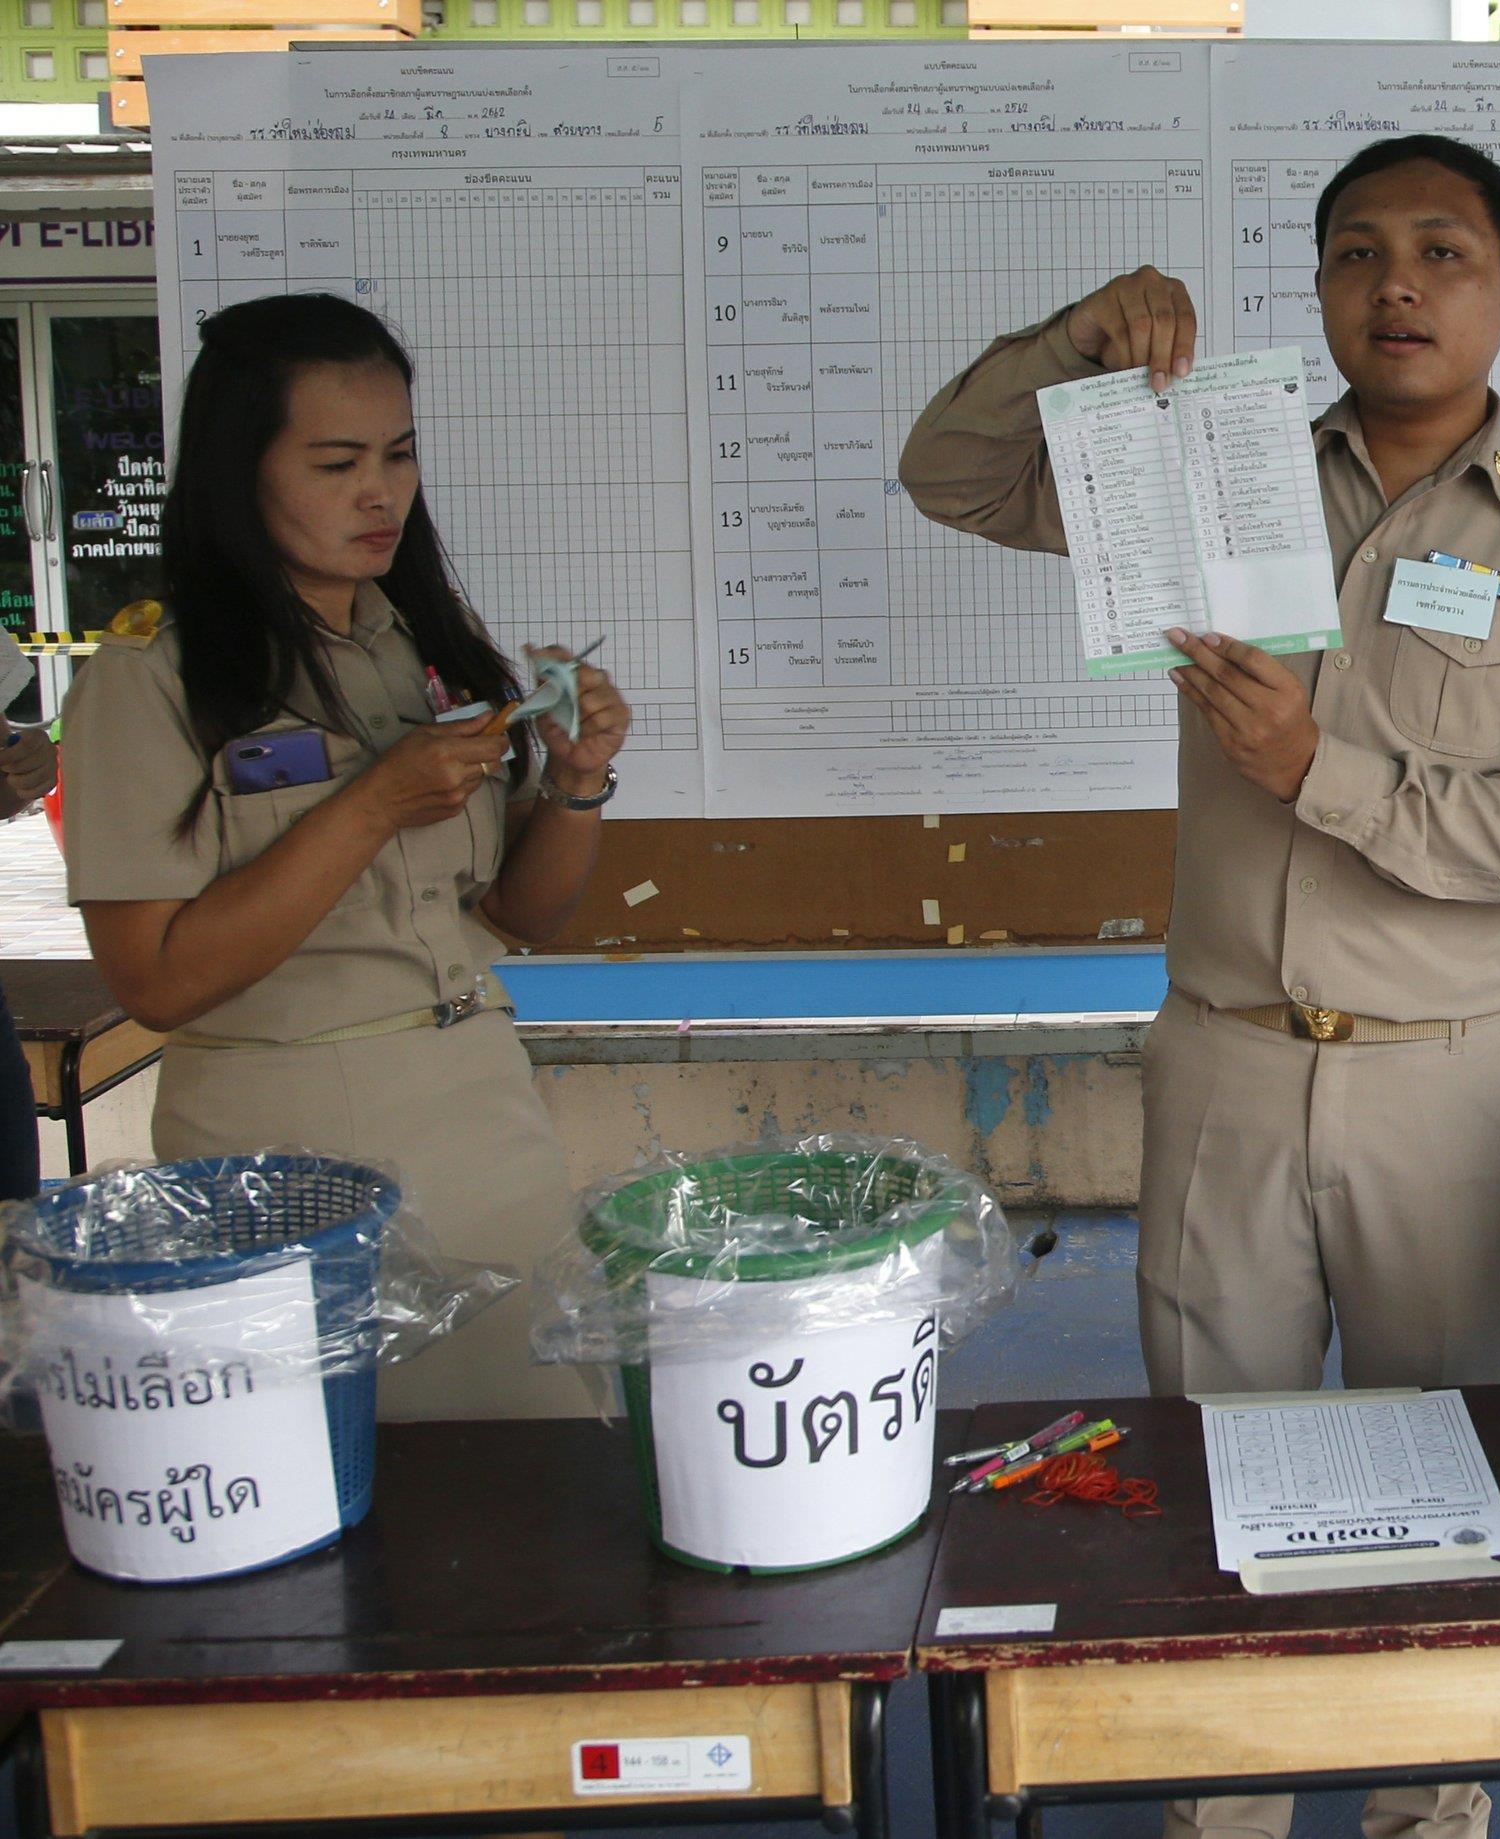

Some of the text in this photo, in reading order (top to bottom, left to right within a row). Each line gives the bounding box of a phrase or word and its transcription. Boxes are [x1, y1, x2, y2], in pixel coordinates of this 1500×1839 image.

[907, 102, 1028, 115] 24 2562
[440, 116, 664, 138] 8 5
[962, 121, 968, 133] 8
[1172, 117, 1182, 128] 5
[1490, 119, 1497, 131] 8
[392, 150, 466, 160] กรุงเทพมหานคร
[914, 143, 990, 154] กรุงเทพมหานคร
[465, 174, 532, 184] ช่องขีดคะแนน
[646, 174, 680, 183] คะแนน
[988, 168, 1054, 177] ช่องขีดคะแนน
[1168, 168, 1201, 176] คะแนน
[653, 191, 670, 199] รวม
[742, 231, 772, 239] นายธนา
[820, 234, 866, 245] ประชาธิปัตย์
[1242, 227, 1263, 243] 16
[194, 240, 203, 255] 1
[300, 239, 339, 248] ชาติพัฒนา
[717, 237, 728, 252] 9
[820, 303, 869, 313] พลังธรรมใหม่
[1243, 296, 1264, 312] 17
[196, 310, 207, 325] 2
[715, 305, 736, 321] 10
[819, 365, 872, 375] ชาติไทยพัฒนา
[716, 375, 737, 390] 11
[719, 442, 741, 458] 12
[118, 456, 165, 477] ปิดทำ
[117, 500, 164, 522] วันหยุ
[836, 508, 865, 519] เพื่อไทย
[79, 512, 115, 528] ผลัก
[721, 511, 743, 527] 13
[767, 520, 816, 531] บุญช่วยเหลือ
[724, 580, 746, 596] 14
[838, 578, 869, 588] เพื่อชาติ
[1416, 600, 1464, 616] เขตห้วยขวาง
[728, 648, 749, 665] 15
[834, 655, 877, 665] ประเทศไทย
[718, 1311, 935, 1468] บัตรดี
[1287, 1524, 1409, 1544] ตัวอย่าง
[590, 1754, 608, 1773] 4
